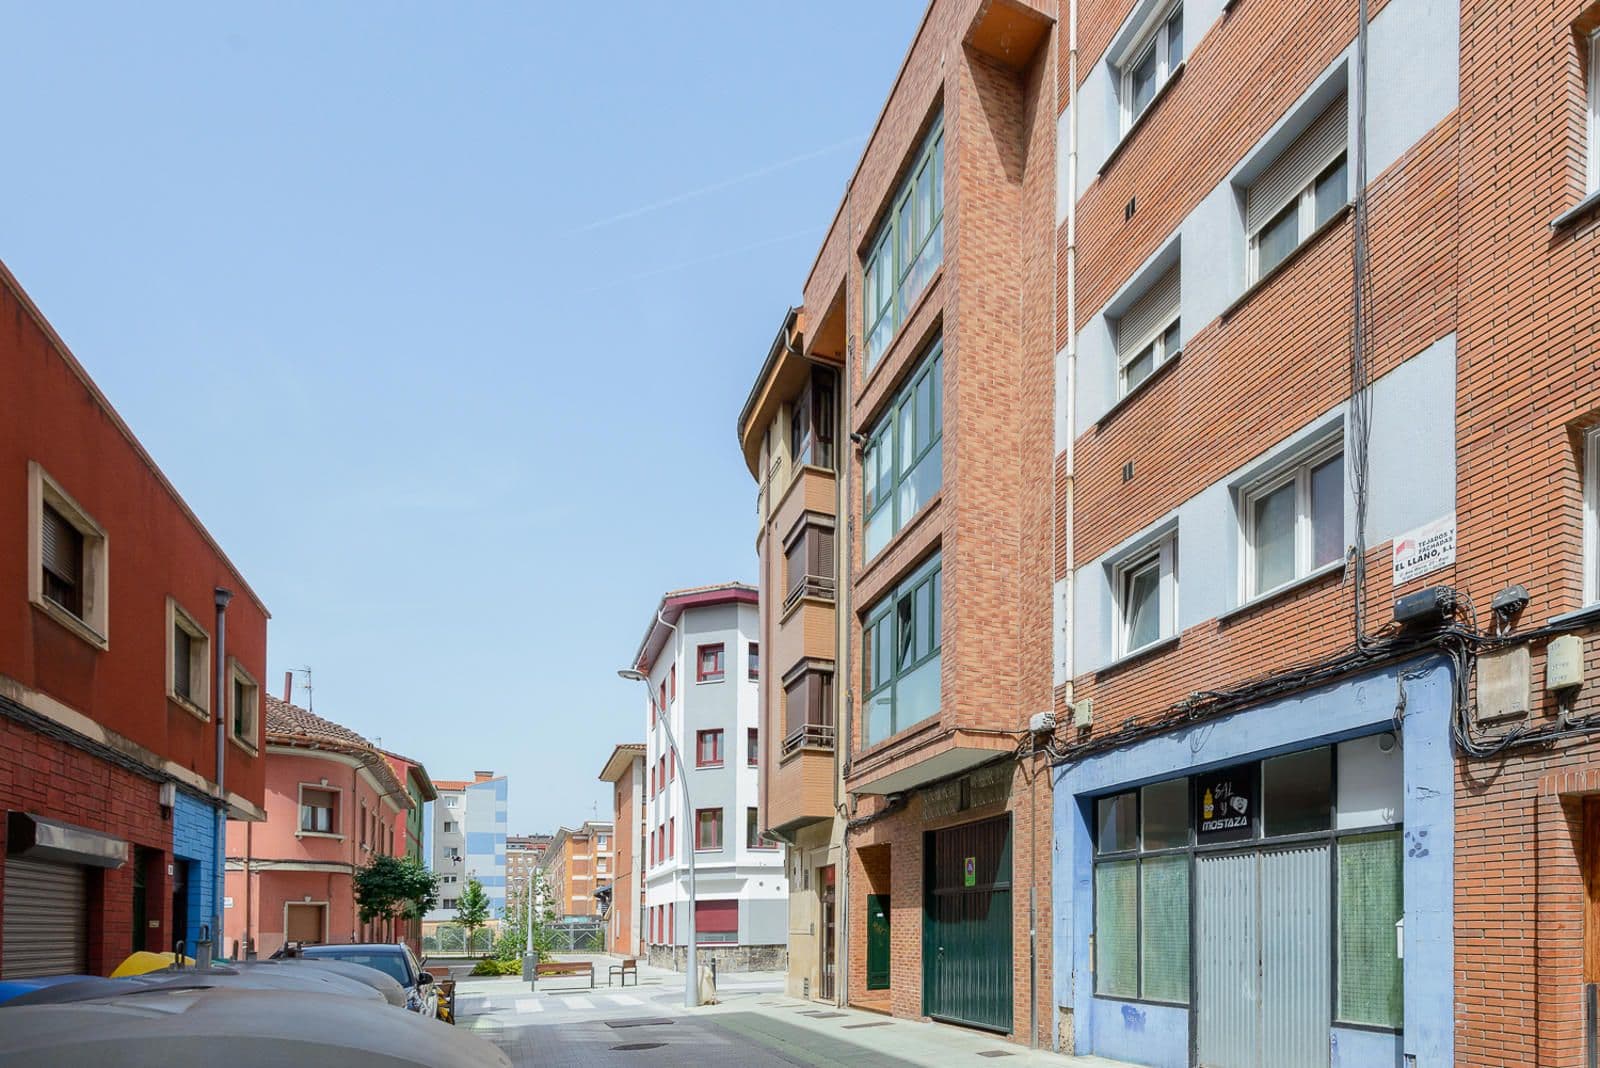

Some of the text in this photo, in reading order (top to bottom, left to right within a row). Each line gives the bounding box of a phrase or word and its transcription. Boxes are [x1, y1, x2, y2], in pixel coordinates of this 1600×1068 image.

[1418, 531, 1448, 547] TEJADOS
[1418, 536, 1453, 554] FACHADAS
[1395, 562, 1405, 572] EL
[1407, 549, 1441, 567] LLANO,
[1214, 781, 1234, 799] SAL
[1202, 816, 1248, 831] MOSTAZA
